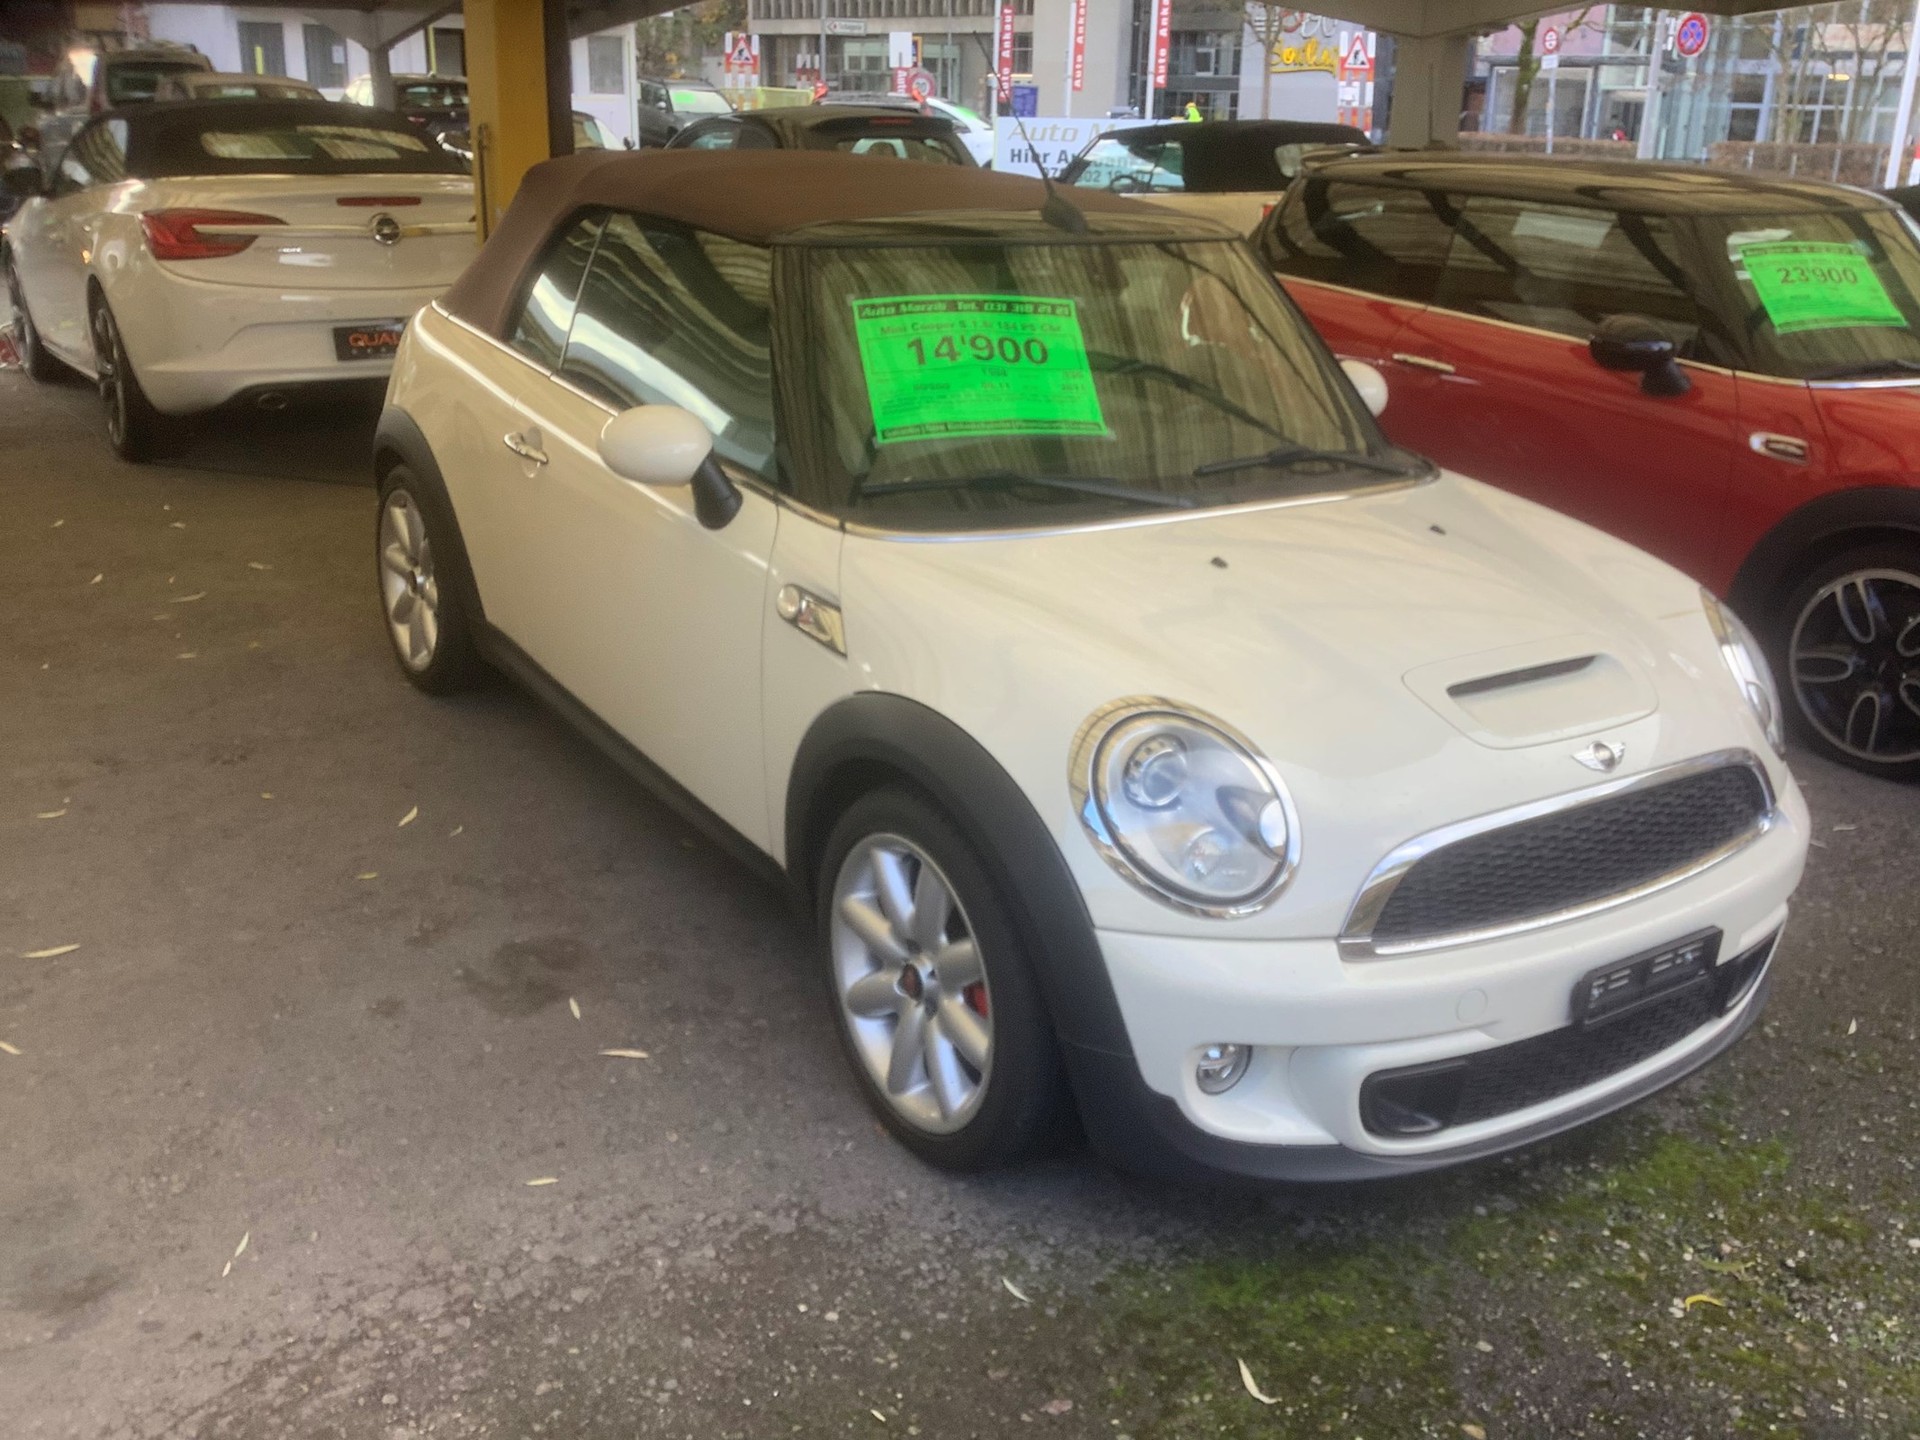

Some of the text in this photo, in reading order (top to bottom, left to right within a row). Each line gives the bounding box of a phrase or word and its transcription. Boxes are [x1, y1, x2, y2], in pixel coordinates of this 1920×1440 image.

[1001, 8, 1013, 58] Ankauf
[1074, 54, 1083, 88] Auto
[1156, 48, 1167, 84] Auto
[1008, 122, 1078, 142] Auto
[1777, 266, 1858, 284] 23'900
[907, 334, 1049, 366] 14'900
